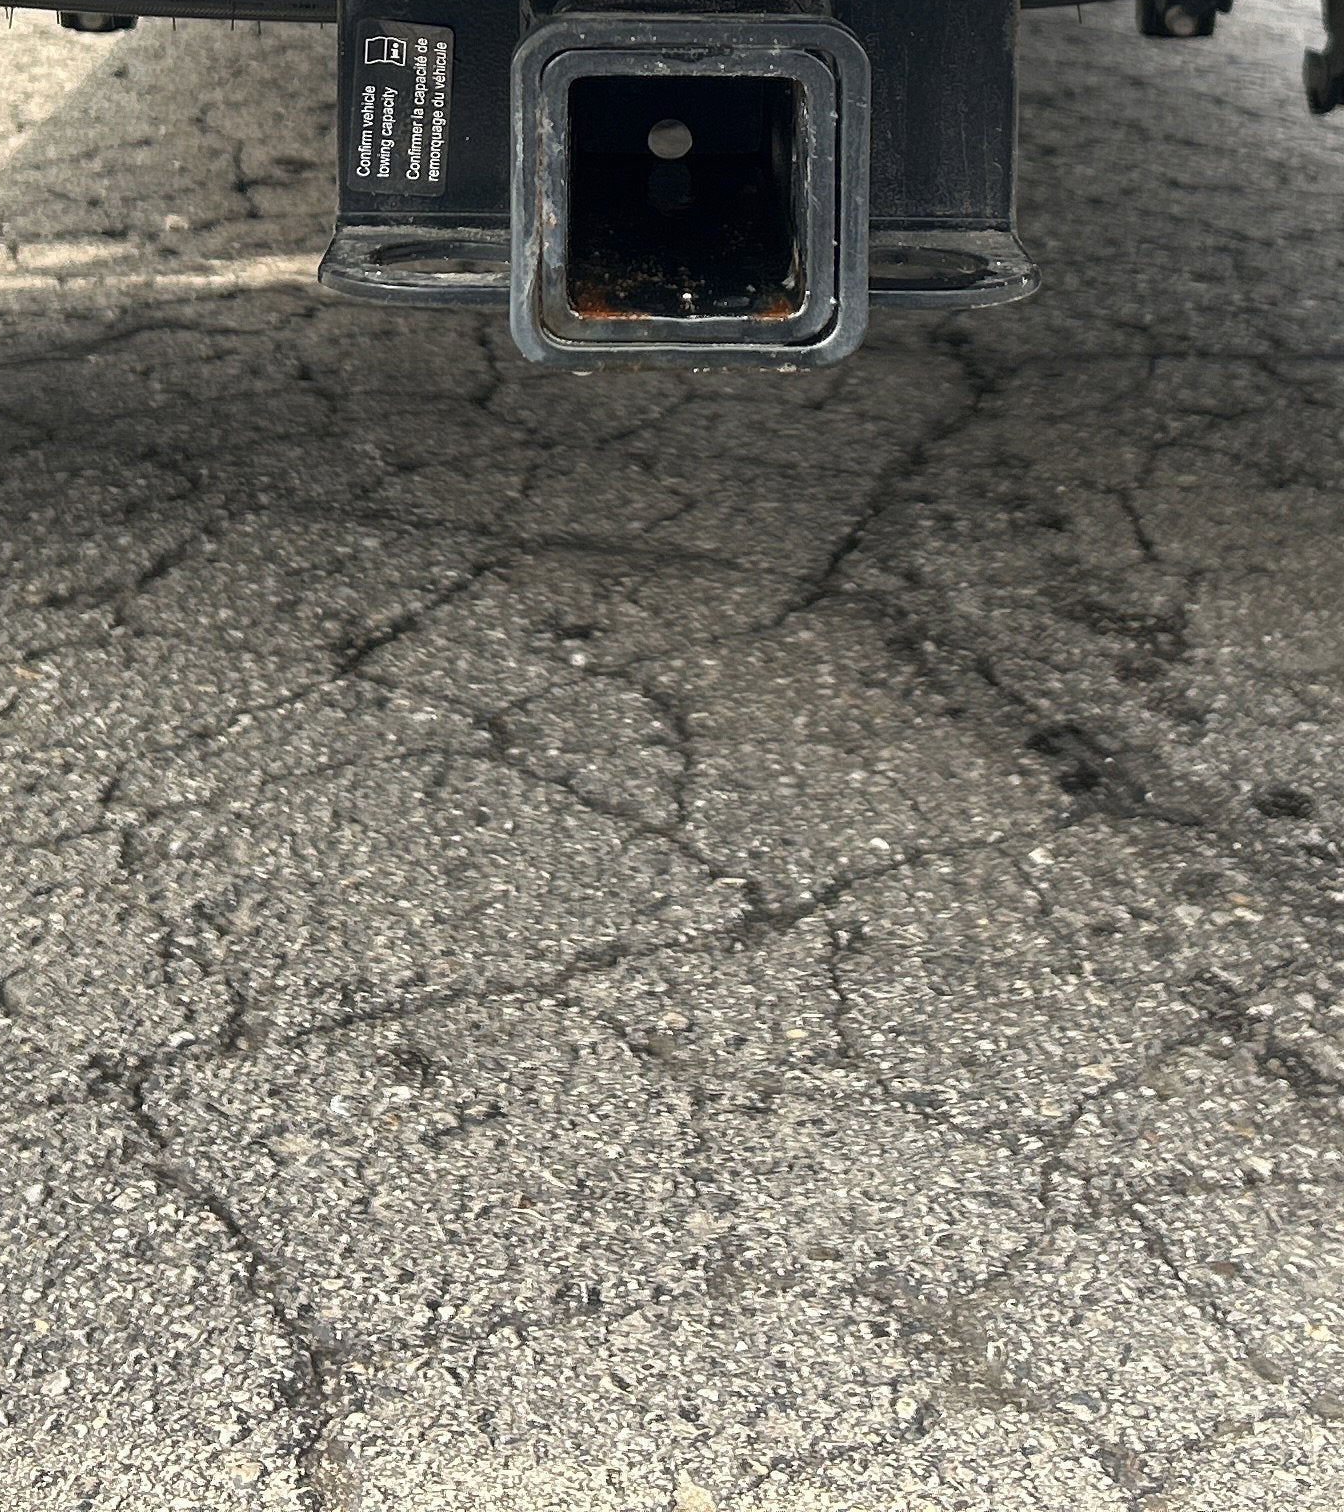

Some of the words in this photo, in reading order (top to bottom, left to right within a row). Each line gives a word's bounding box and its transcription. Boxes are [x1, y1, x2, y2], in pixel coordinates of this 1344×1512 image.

[416, 37, 428, 54] de
[432, 41, 448, 90] véhicule
[414, 56, 428, 106] capacité
[431, 92, 445, 108] du
[360, 85, 376, 128] vehicle
[380, 86, 398, 137] capacity
[410, 108, 424, 119] la
[356, 129, 373, 178] Confirm
[376, 139, 395, 178] towing
[405, 121, 424, 180] Confirmer
[428, 110, 447, 182] remorquage
